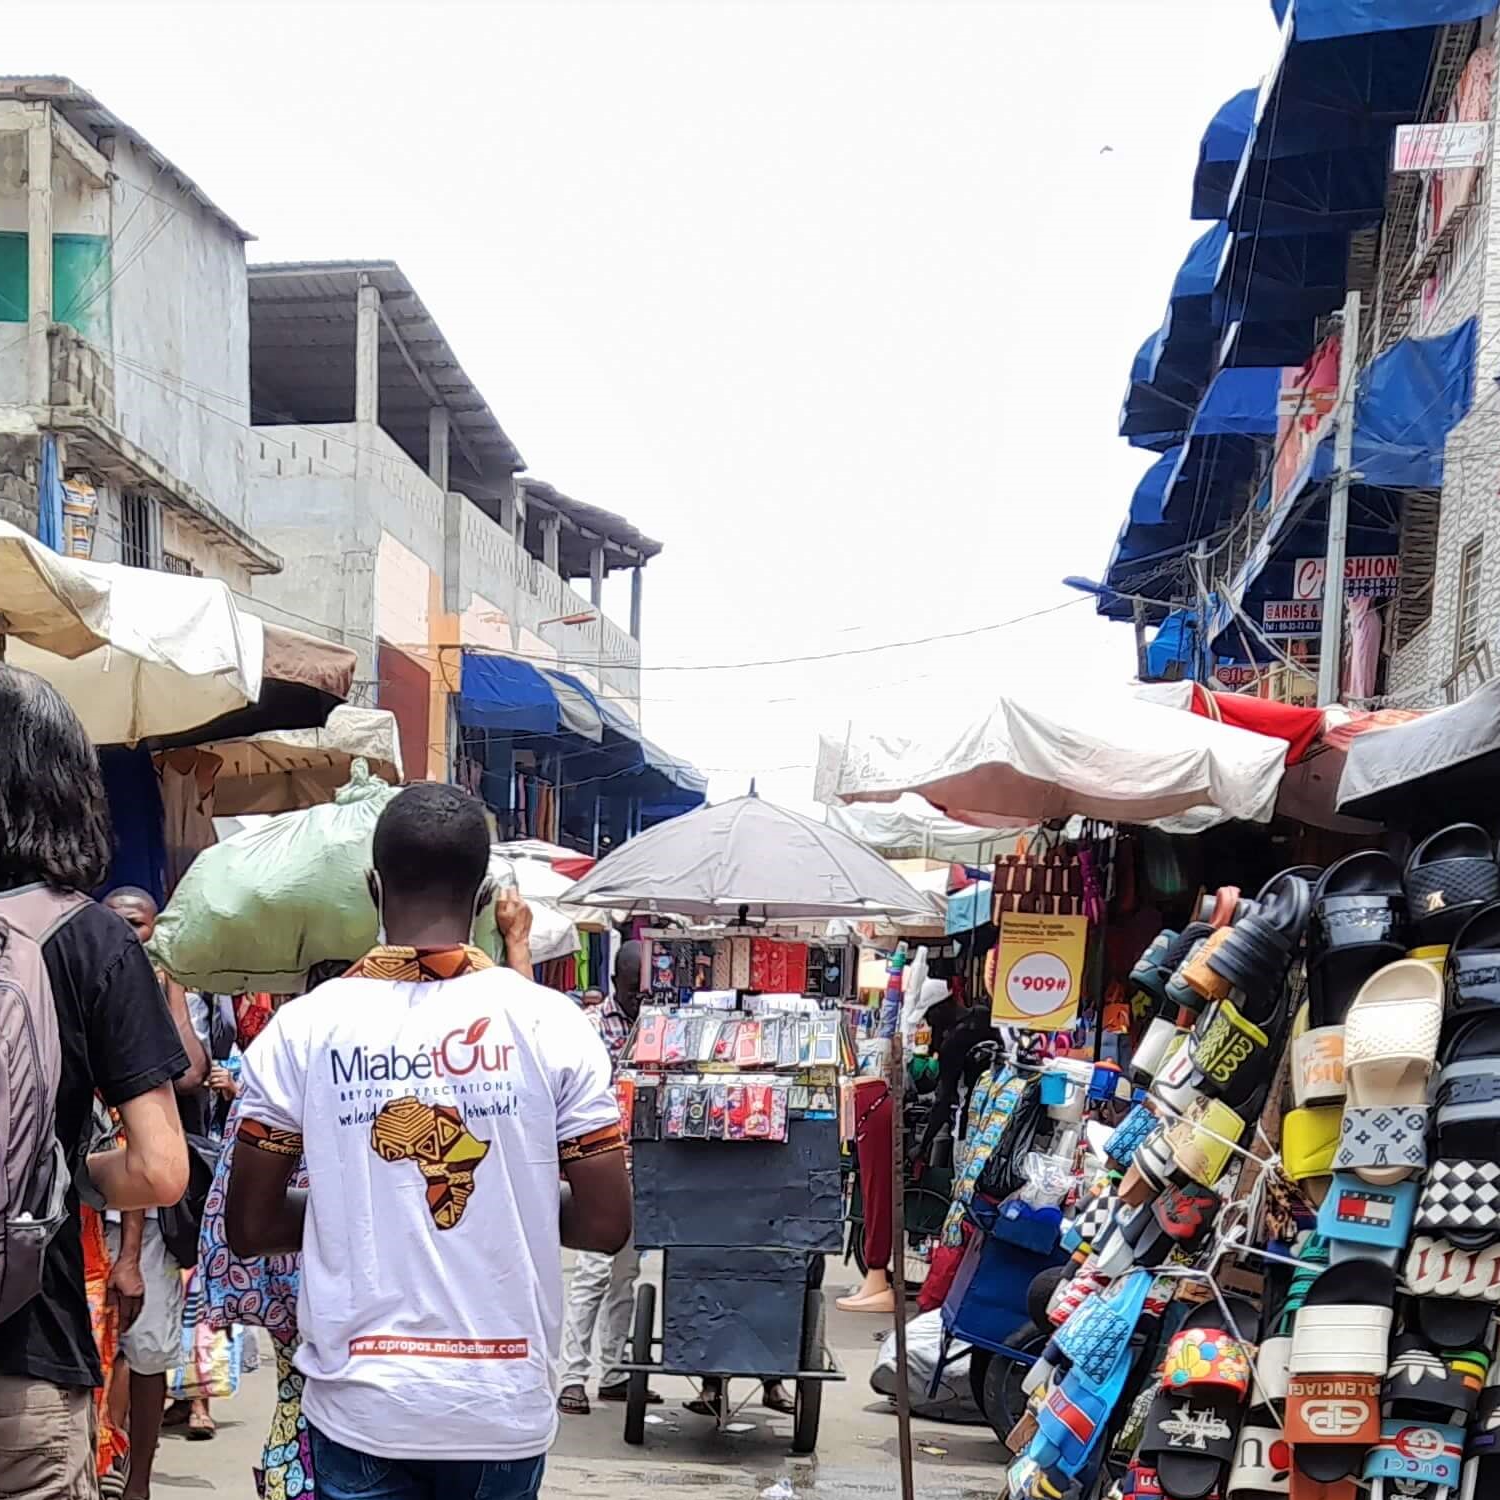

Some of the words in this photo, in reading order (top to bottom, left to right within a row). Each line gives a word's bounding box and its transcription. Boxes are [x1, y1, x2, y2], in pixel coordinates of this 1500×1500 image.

[1342, 557, 1398, 578] SHION
[1274, 603, 1307, 619] ARISE
[340, 1087, 394, 1102] BEYOND
[403, 1080, 513, 1098] EXPECTATIONS
[1384, 1457, 1450, 1478] GUCCI
